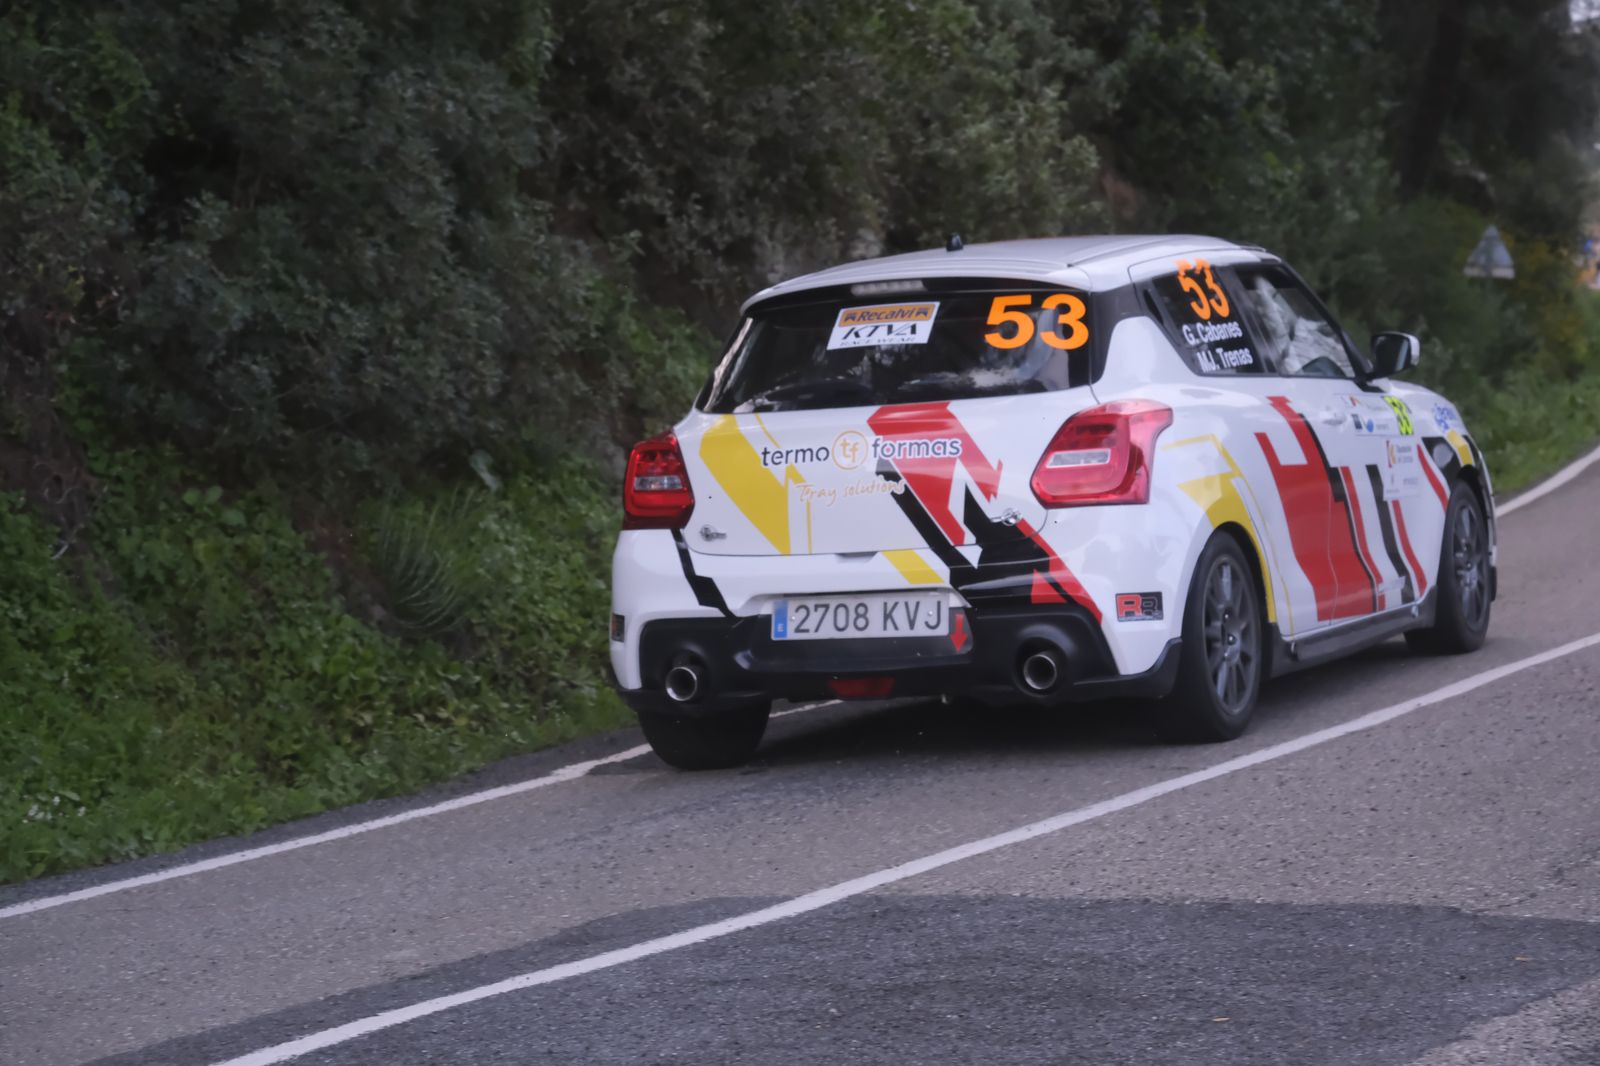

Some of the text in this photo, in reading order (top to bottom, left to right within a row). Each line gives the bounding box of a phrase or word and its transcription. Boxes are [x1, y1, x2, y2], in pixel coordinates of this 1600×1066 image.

[1175, 258, 1230, 320] 53
[857, 308, 915, 322] Recalvi
[984, 293, 1089, 350] 53
[1182, 324, 1199, 346] G.
[1216, 347, 1253, 368] Trenas
[762, 438, 962, 466] termo tf formas
[844, 480, 905, 496] solutions
[794, 602, 870, 633] 2708
[883, 600, 942, 631] KVJ
